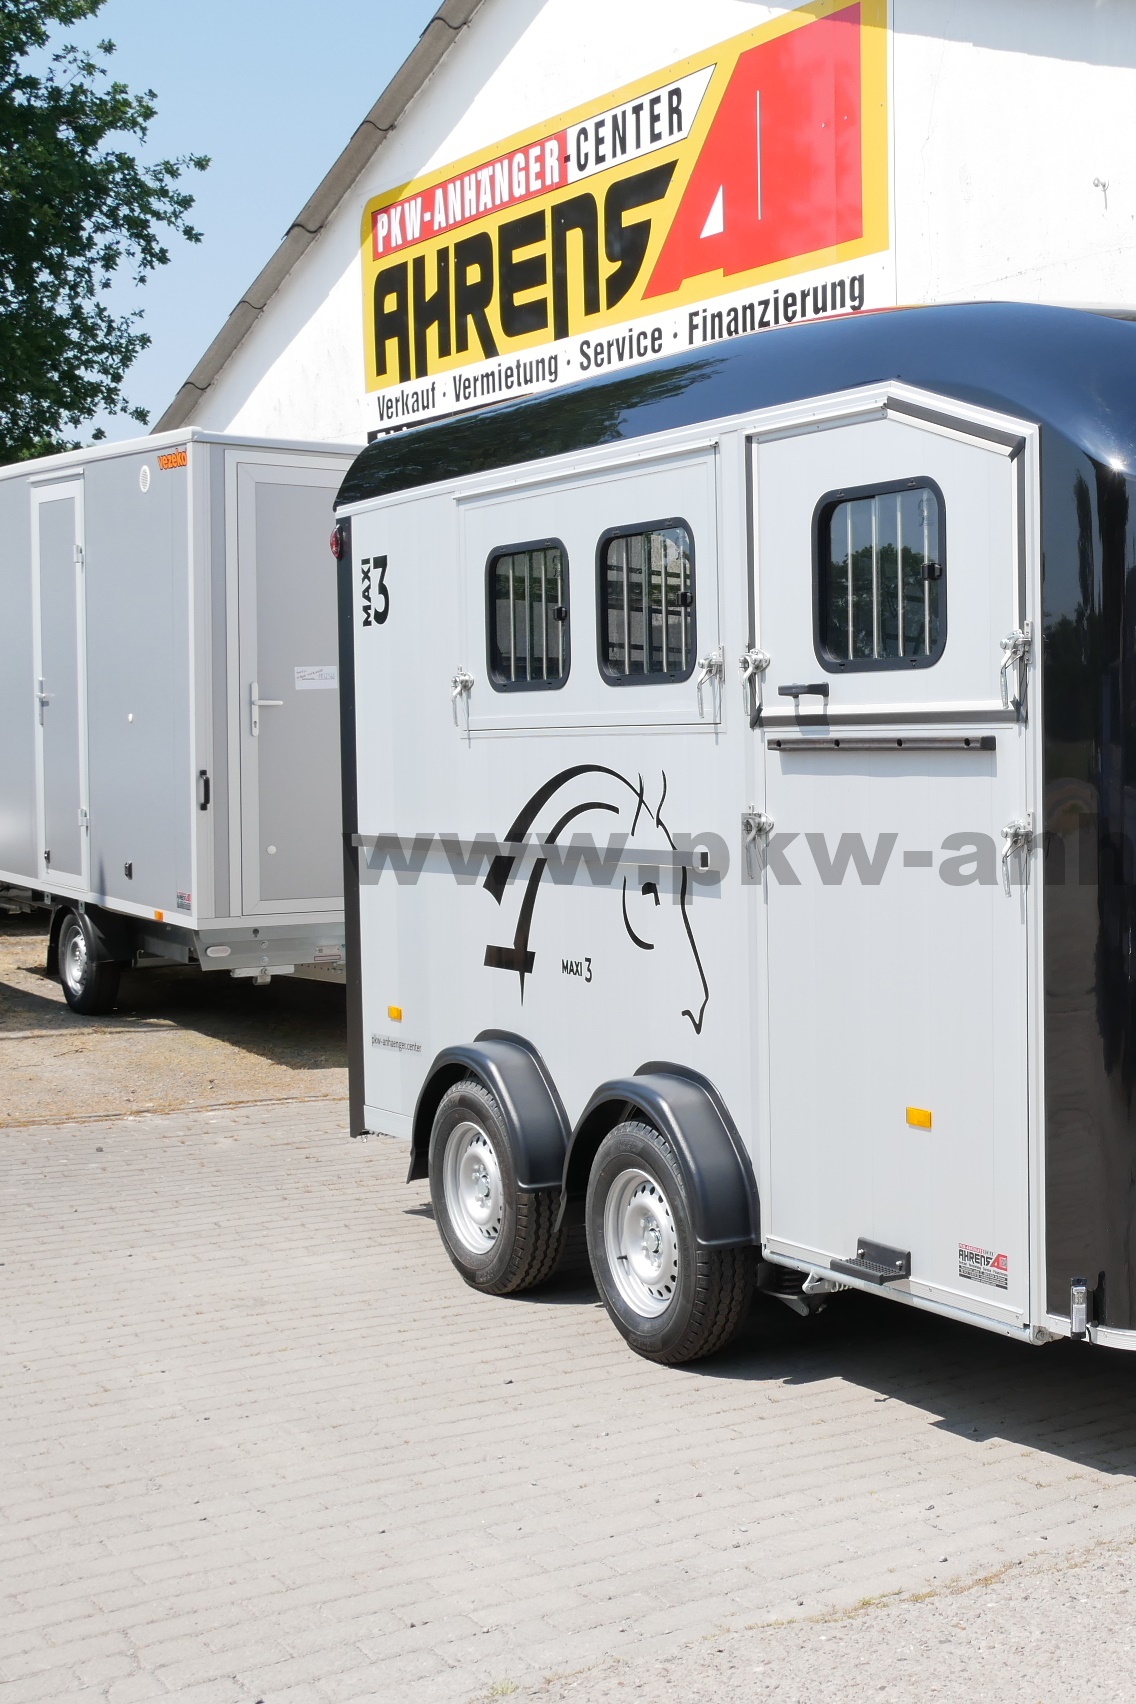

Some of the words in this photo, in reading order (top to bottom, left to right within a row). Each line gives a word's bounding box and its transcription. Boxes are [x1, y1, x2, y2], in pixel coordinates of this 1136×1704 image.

[376, 86, 684, 254] PKW-ANHÄNGER-CENTER
[377, 381, 436, 422] Verkauf
[452, 353, 559, 403] Vermietung
[579, 326, 664, 371] Service
[688, 273, 866, 346] Finanzierung
[157, 447, 188, 471] vezeko
[361, 557, 372, 627] MAXI
[372, 555, 390, 625] 3
[561, 958, 583, 977] MAXI
[584, 956, 593, 983] 3
[958, 1248, 993, 1267] AHRENS
